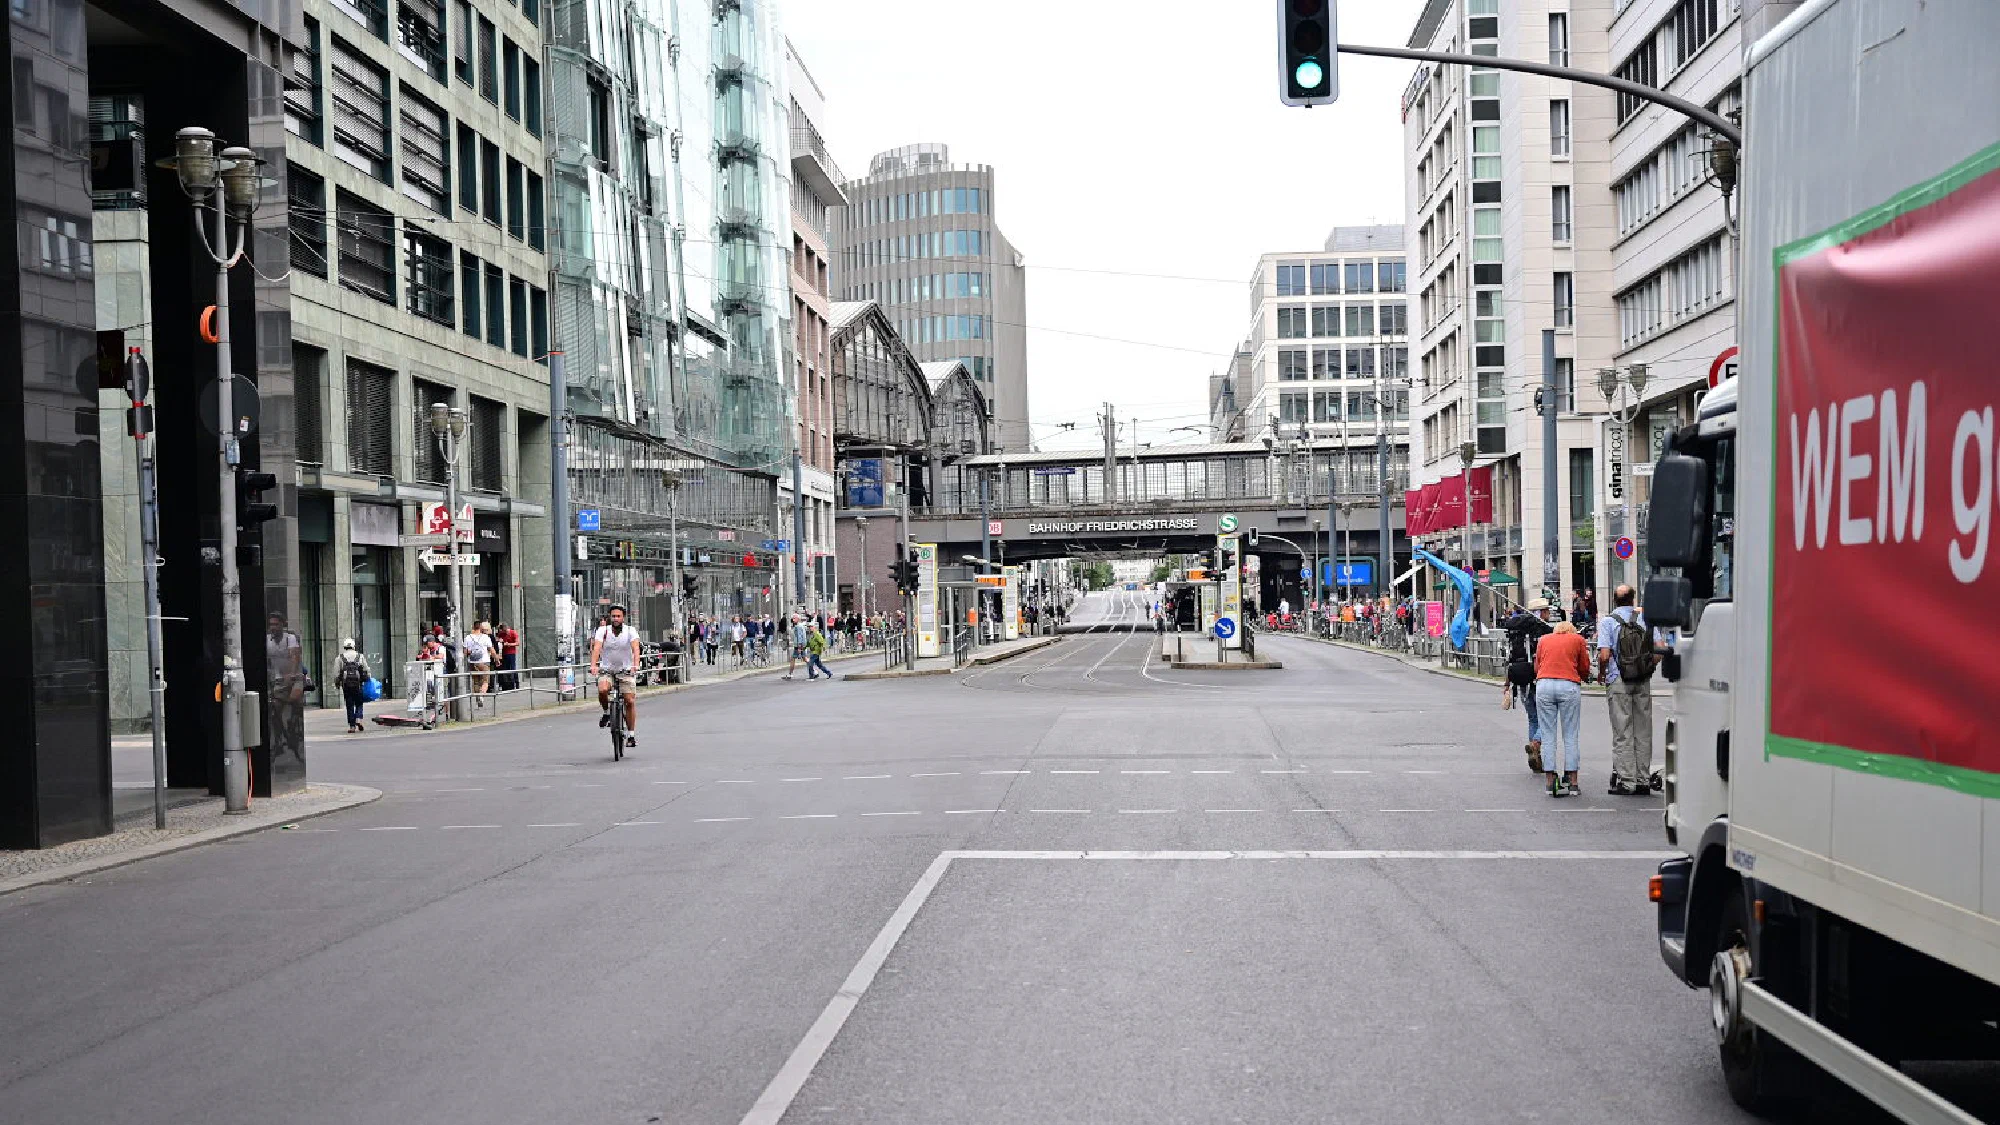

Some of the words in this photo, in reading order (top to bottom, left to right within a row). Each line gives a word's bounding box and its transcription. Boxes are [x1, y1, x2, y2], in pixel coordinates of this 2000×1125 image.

[1029, 522, 1084, 533] BAHNHOF
[1086, 518, 1198, 532] FRIEDRICHSTRASSE
[1791, 379, 1927, 551] WEM
[1948, 404, 2000, 583] g
